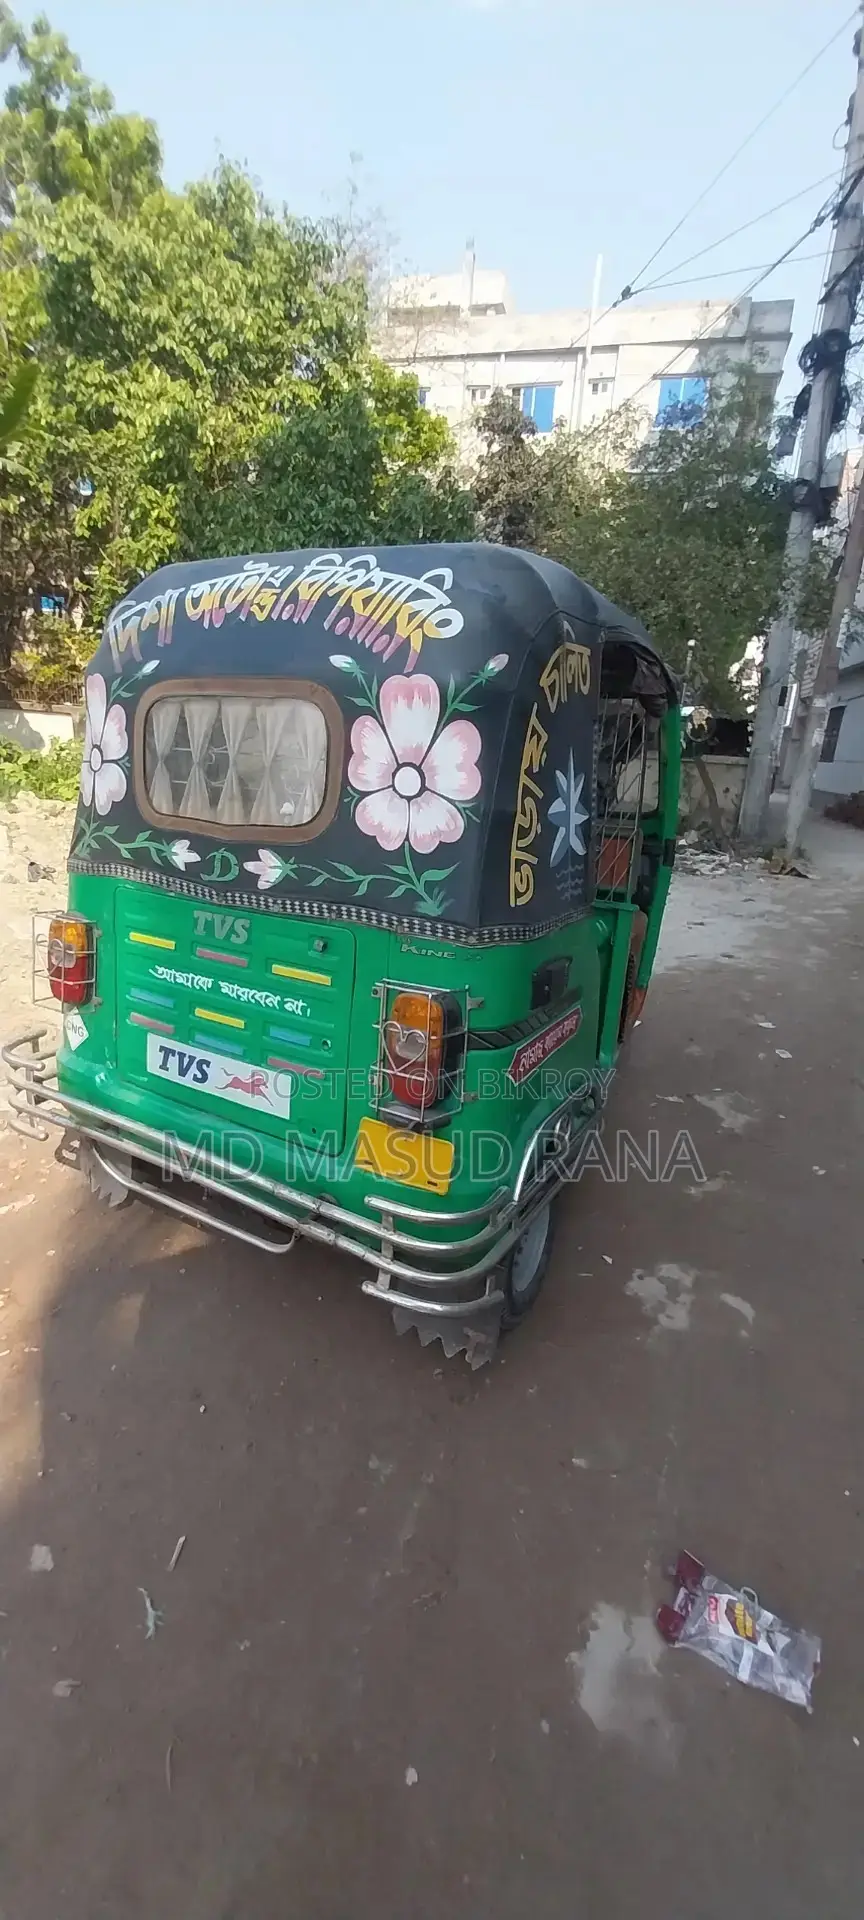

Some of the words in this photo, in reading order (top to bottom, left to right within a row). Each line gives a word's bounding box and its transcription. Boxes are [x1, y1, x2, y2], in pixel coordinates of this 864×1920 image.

[107, 588, 186, 673] দিশা
[509, 702, 548, 908] ভাড়ায়
[539, 619, 591, 714] চালিত
[193, 910, 251, 945] TVS
[148, 964, 214, 992] আমাকে
[218, 980, 281, 1010] মারবেন
[283, 997, 311, 1017] না।
[66, 1019, 84, 1037] CNG
[158, 1045, 212, 1085] TVS
